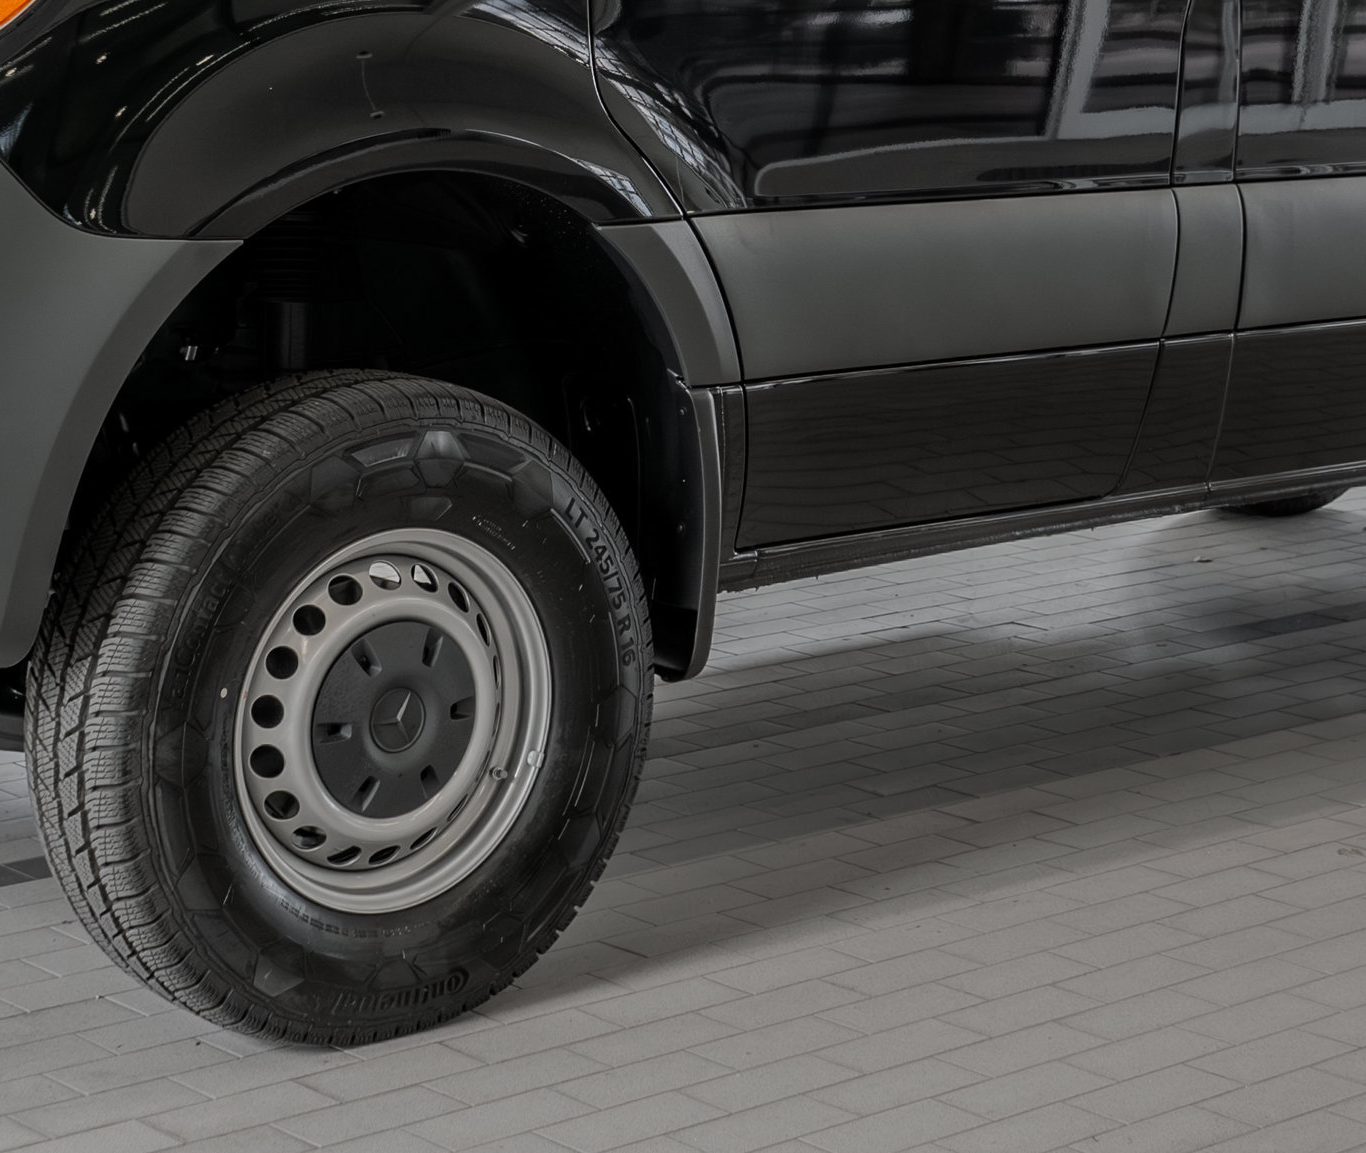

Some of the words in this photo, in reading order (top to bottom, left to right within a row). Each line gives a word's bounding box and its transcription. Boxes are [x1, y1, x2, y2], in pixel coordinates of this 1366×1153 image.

[565, 497, 588, 528] LT
[585, 528, 626, 611] 245/75
[617, 618, 631, 635] R
[621, 638, 635, 667] 16
